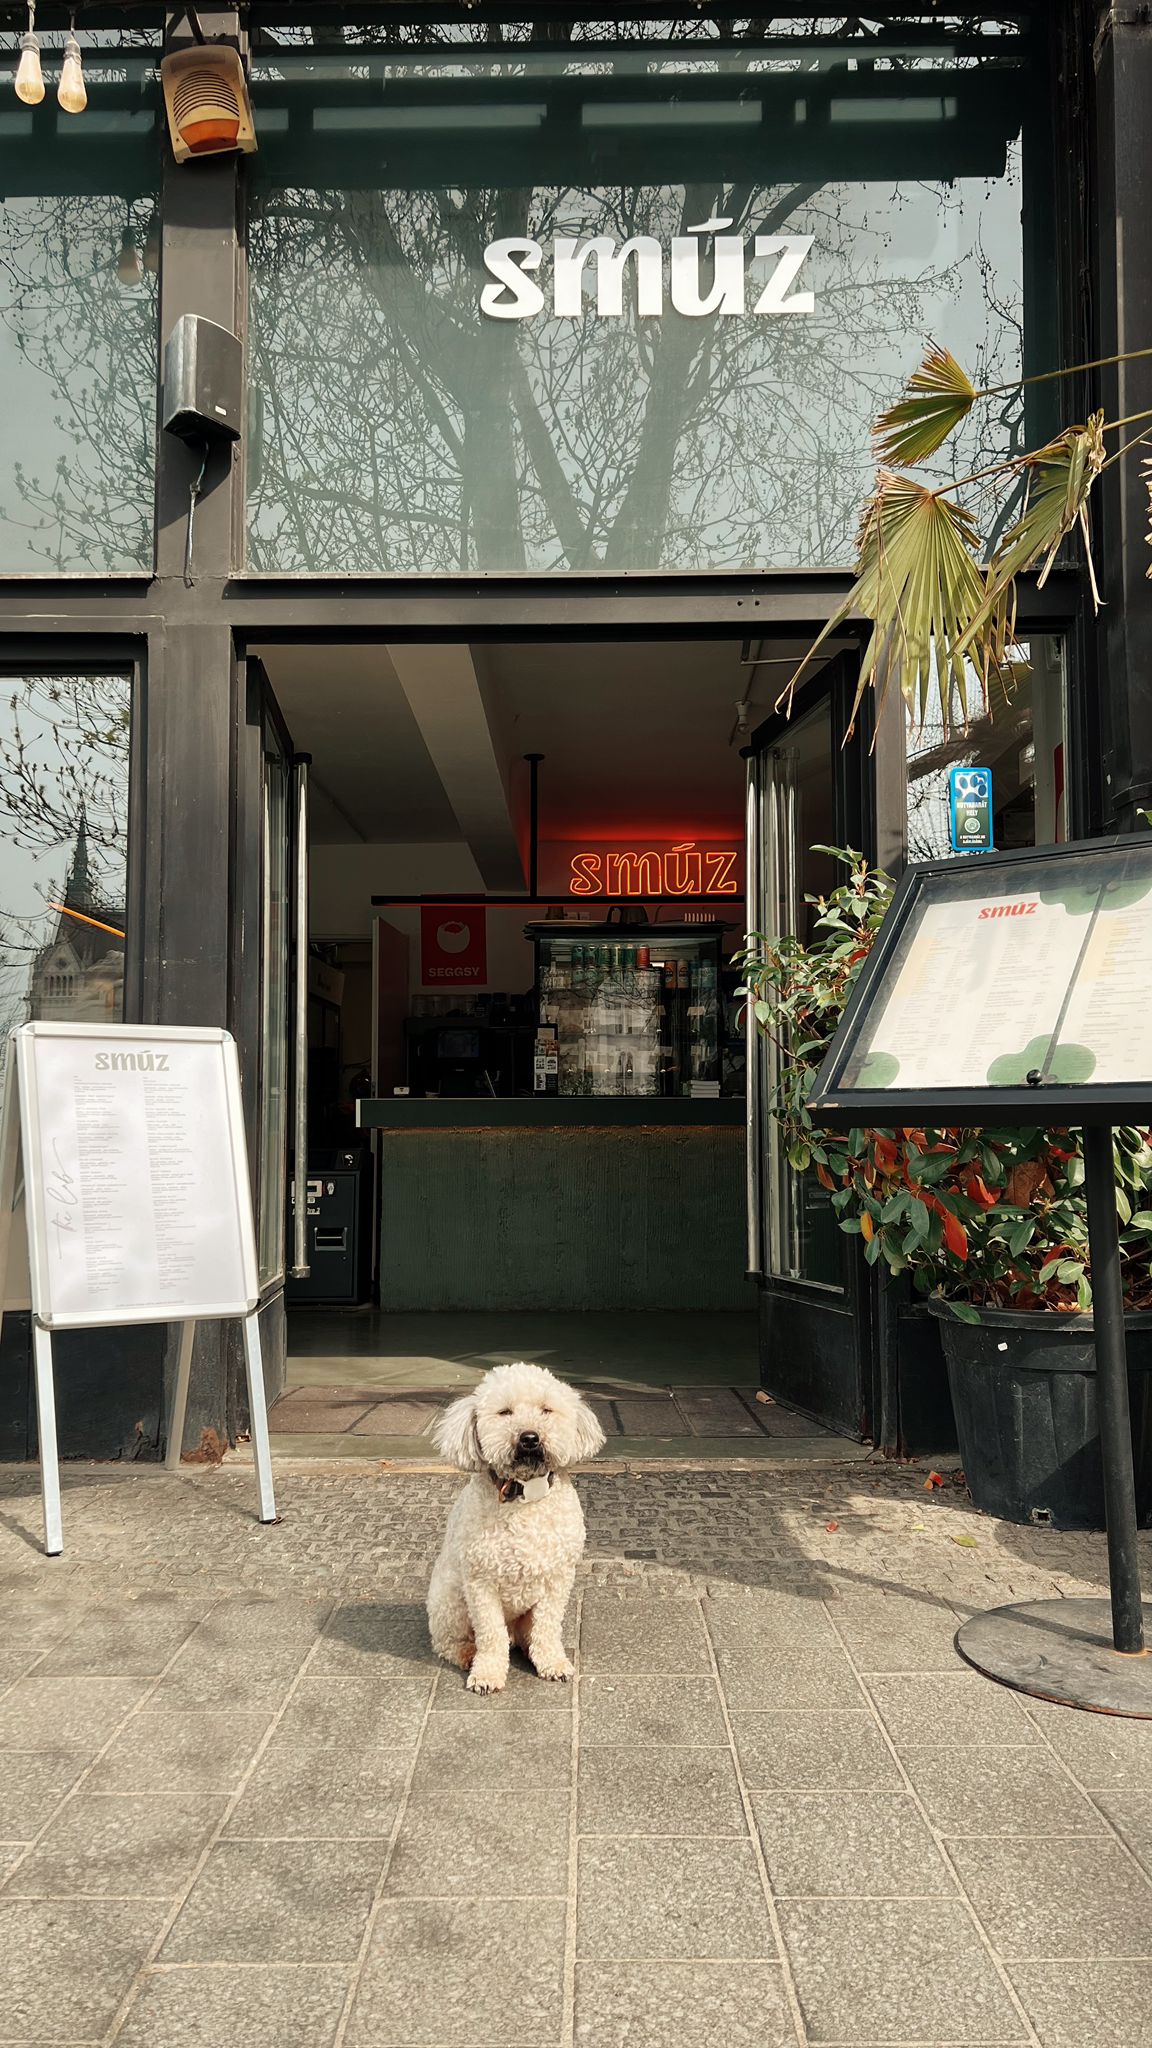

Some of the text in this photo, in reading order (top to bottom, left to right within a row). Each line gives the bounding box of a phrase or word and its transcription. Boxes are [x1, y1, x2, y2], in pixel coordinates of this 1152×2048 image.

[480, 217, 816, 319] smúz
[569, 842, 738, 896] smúz
[977, 902, 1039, 920] smúz
[428, 967, 480, 977] SEGGSY
[95, 1050, 170, 1072] smúz
